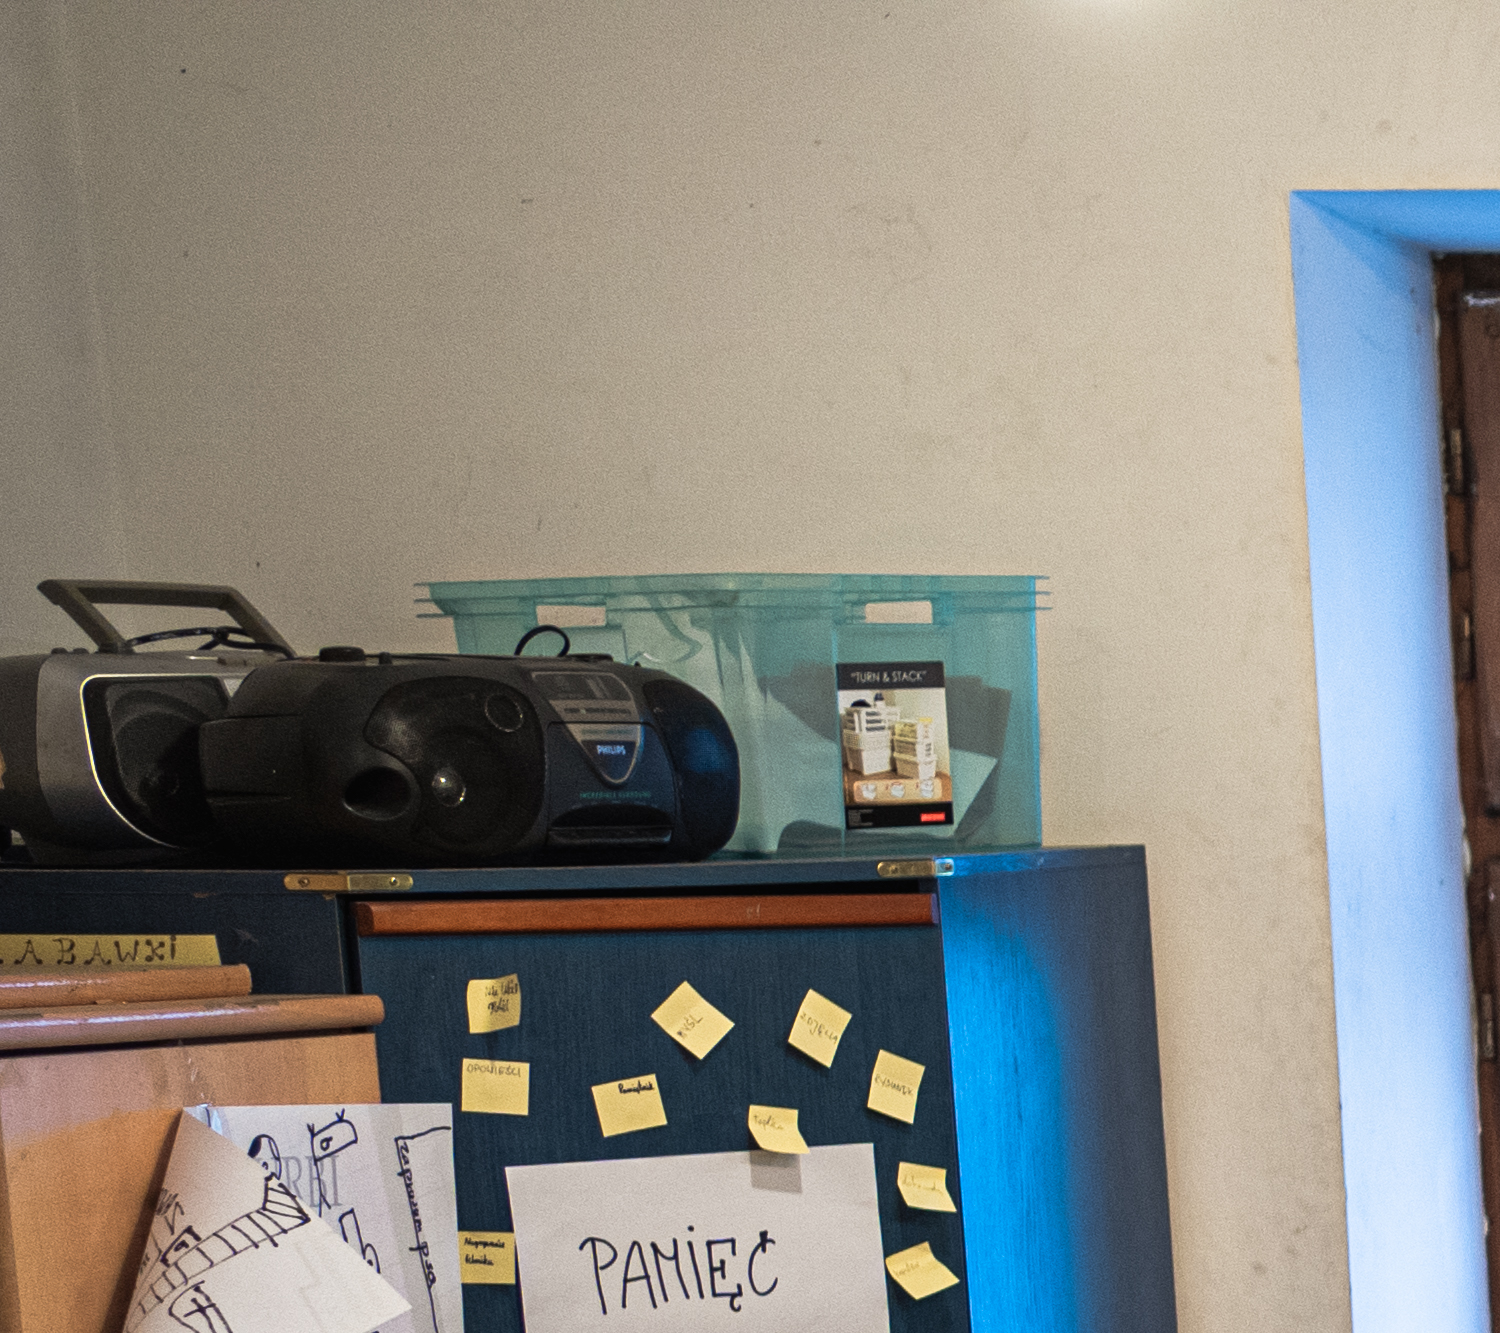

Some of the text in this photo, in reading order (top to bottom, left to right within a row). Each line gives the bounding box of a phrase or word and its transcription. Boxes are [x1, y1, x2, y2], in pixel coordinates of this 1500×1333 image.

[883, 674, 890, 683] &
[597, 745, 626, 756] PHILIPS
[579, 1225, 778, 1315] PAMIĘĆ
